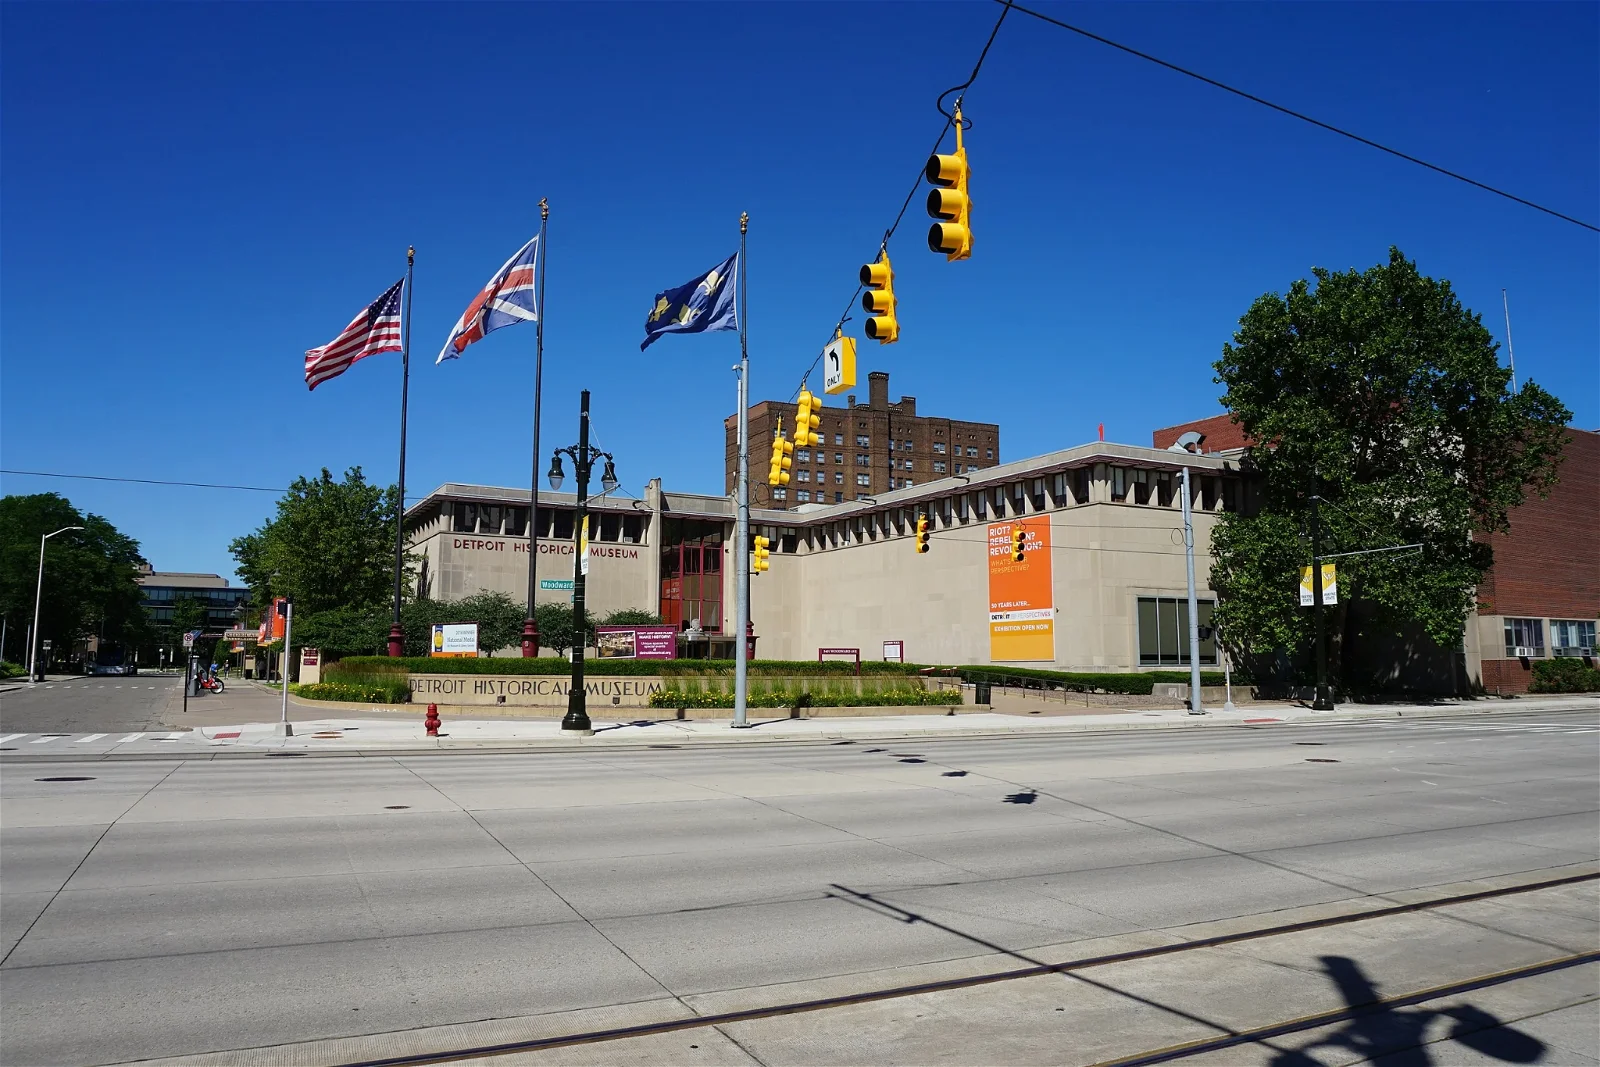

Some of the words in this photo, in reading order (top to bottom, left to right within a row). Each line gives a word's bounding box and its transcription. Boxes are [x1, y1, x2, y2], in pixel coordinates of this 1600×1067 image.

[827, 373, 840, 387] ONLY
[990, 526, 1010, 537] RIOT?
[990, 532, 1035, 547] REBELN?
[454, 539, 505, 552] DETROIT
[514, 542, 575, 555] HISTORICA
[590, 547, 638, 559] MUSEUM
[990, 541, 1043, 556] REVOLION?
[541, 581, 574, 589] Woodward
[409, 680, 466, 695] DETROIT
[474, 680, 570, 696] HISTORICAL
[584, 681, 662, 696] MUSEUM
